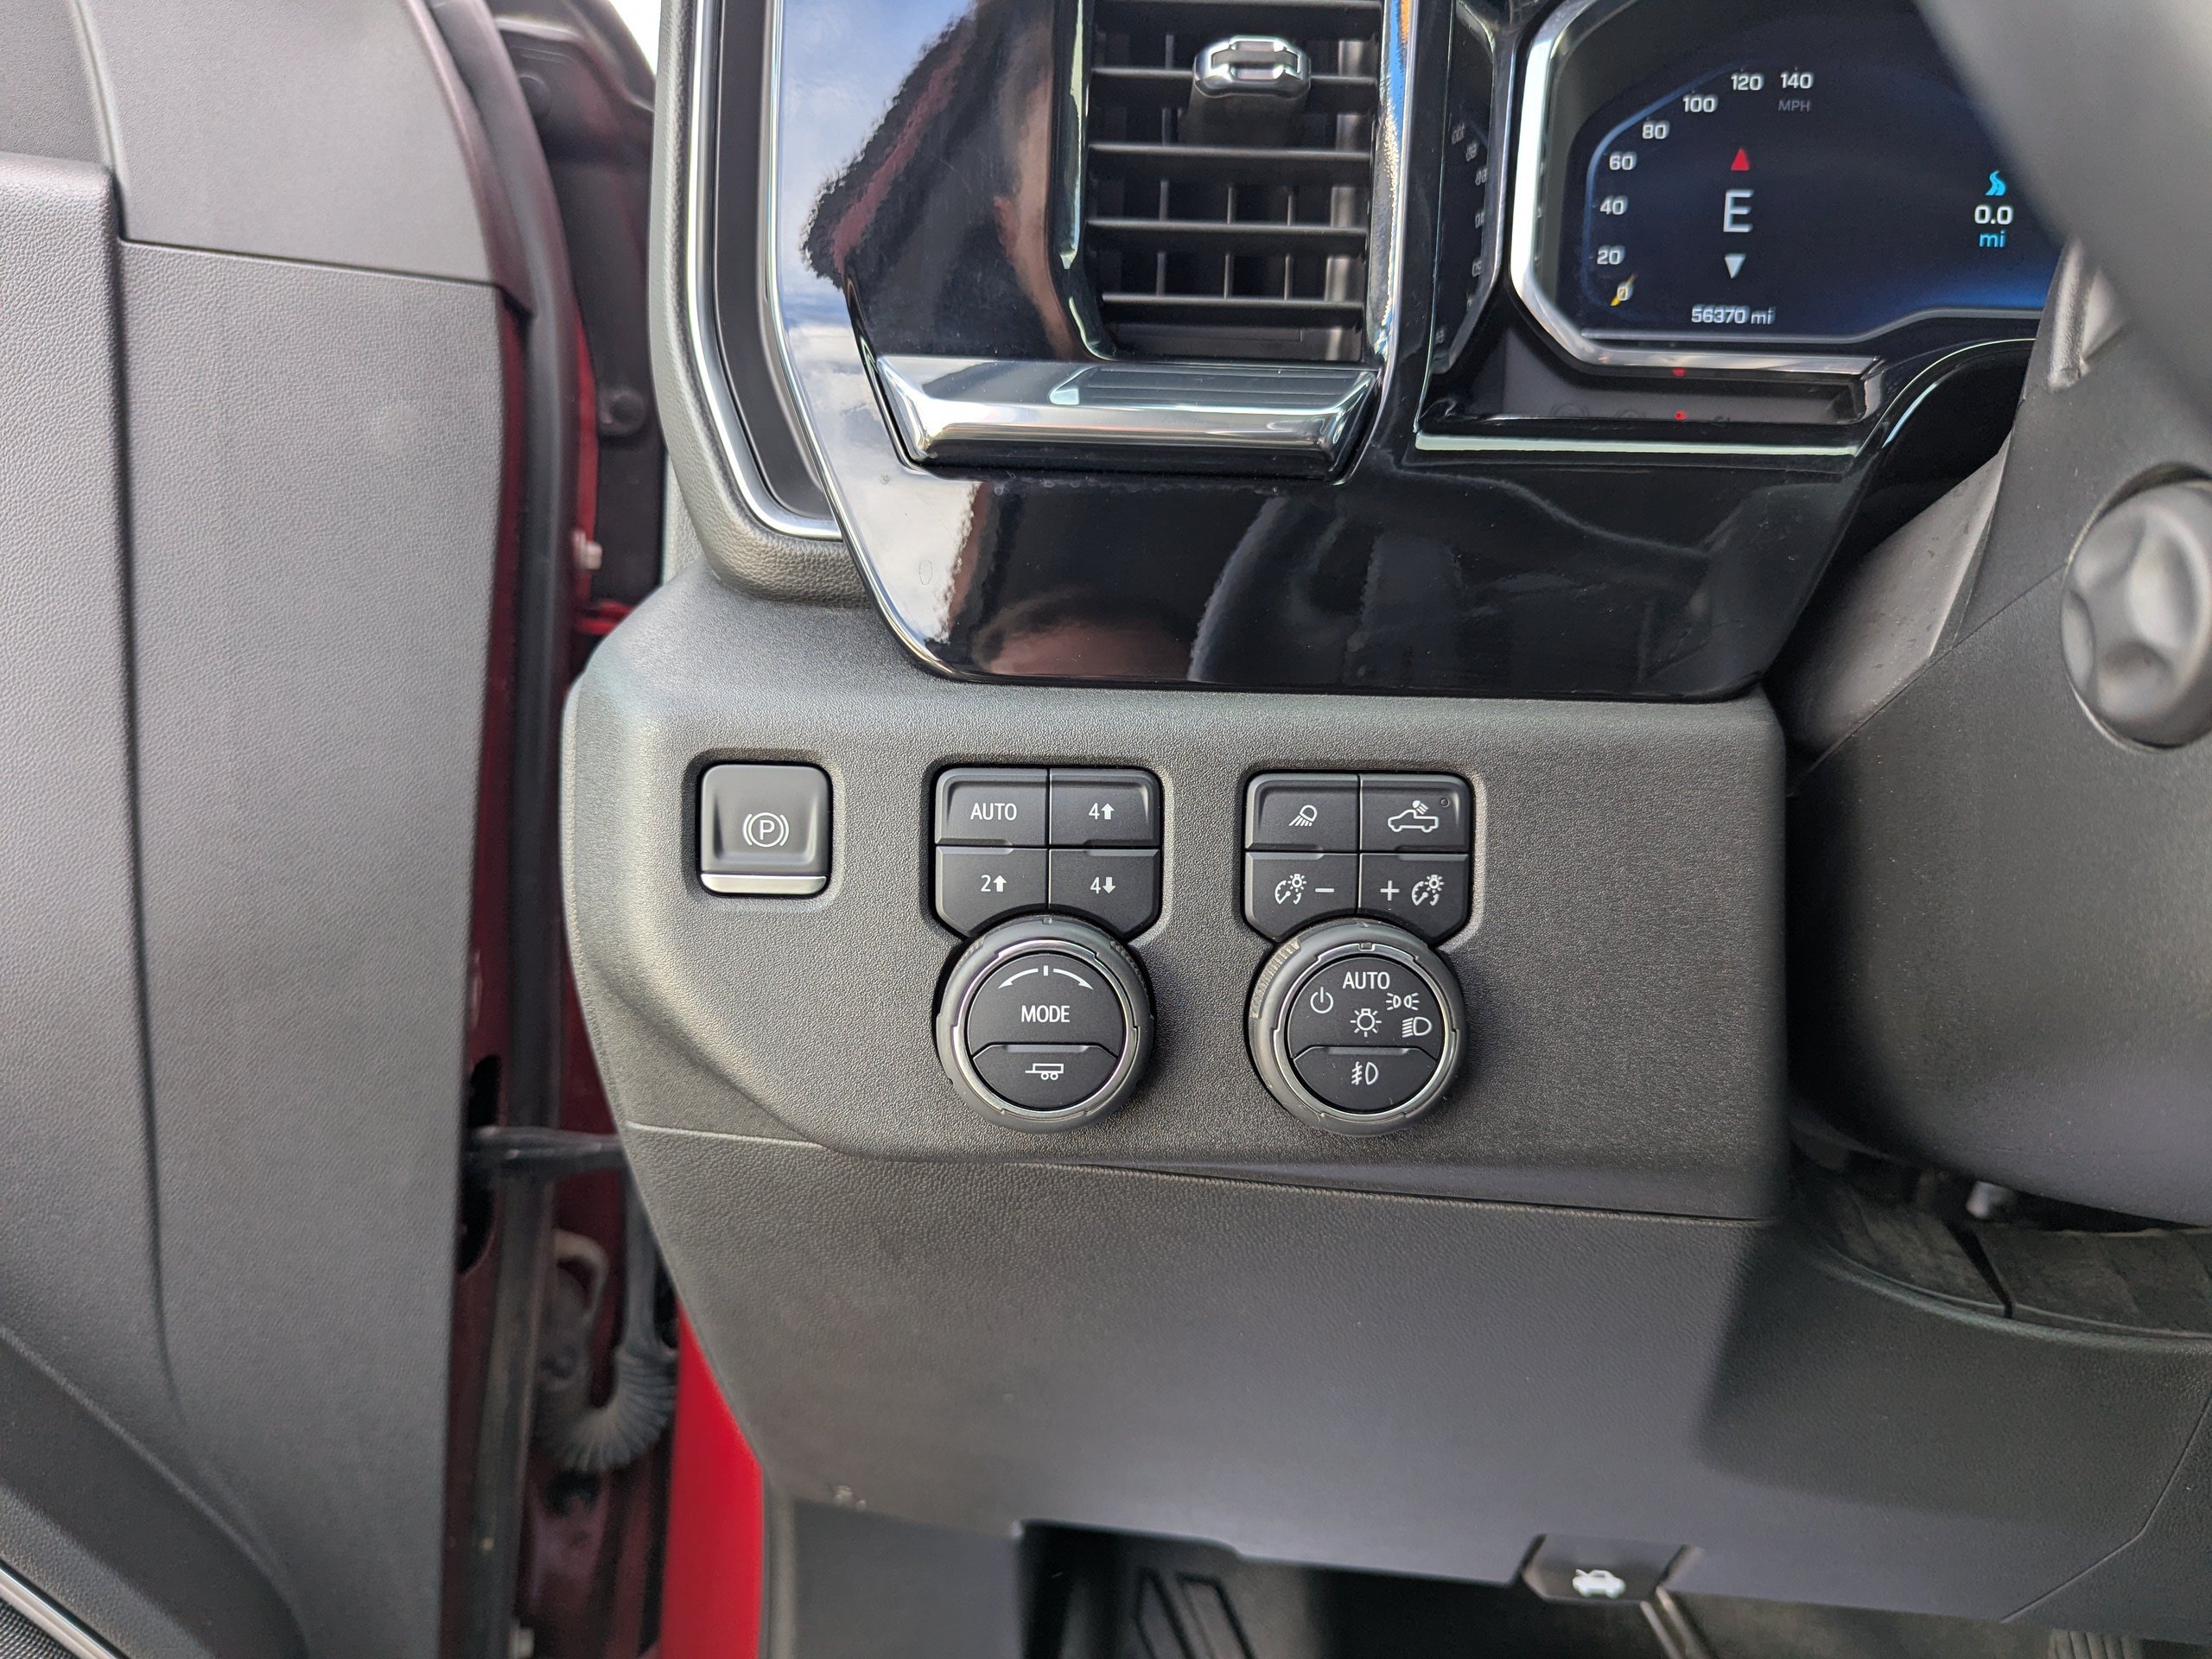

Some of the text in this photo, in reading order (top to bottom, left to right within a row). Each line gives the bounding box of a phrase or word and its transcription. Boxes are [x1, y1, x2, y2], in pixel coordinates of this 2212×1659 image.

[1731, 73, 1764, 91] 120
[1780, 72, 1813, 89] 140
[1682, 94, 1718, 113] 100
[1778, 99, 1811, 112] MPH
[1642, 120, 1669, 140] 80
[1609, 151, 1637, 171] 60
[1599, 195, 1628, 215] 40
[1723, 188, 1754, 232] E
[1974, 204, 2014, 225] 0.0
[1979, 229, 2006, 248] mi
[1597, 245, 1625, 265] 20
[1691, 304, 1777, 325] 56370 mi
[969, 803, 1018, 821] AUTO
[1342, 971, 1390, 990] AUTO
[1020, 1004, 1071, 1024] MODE
